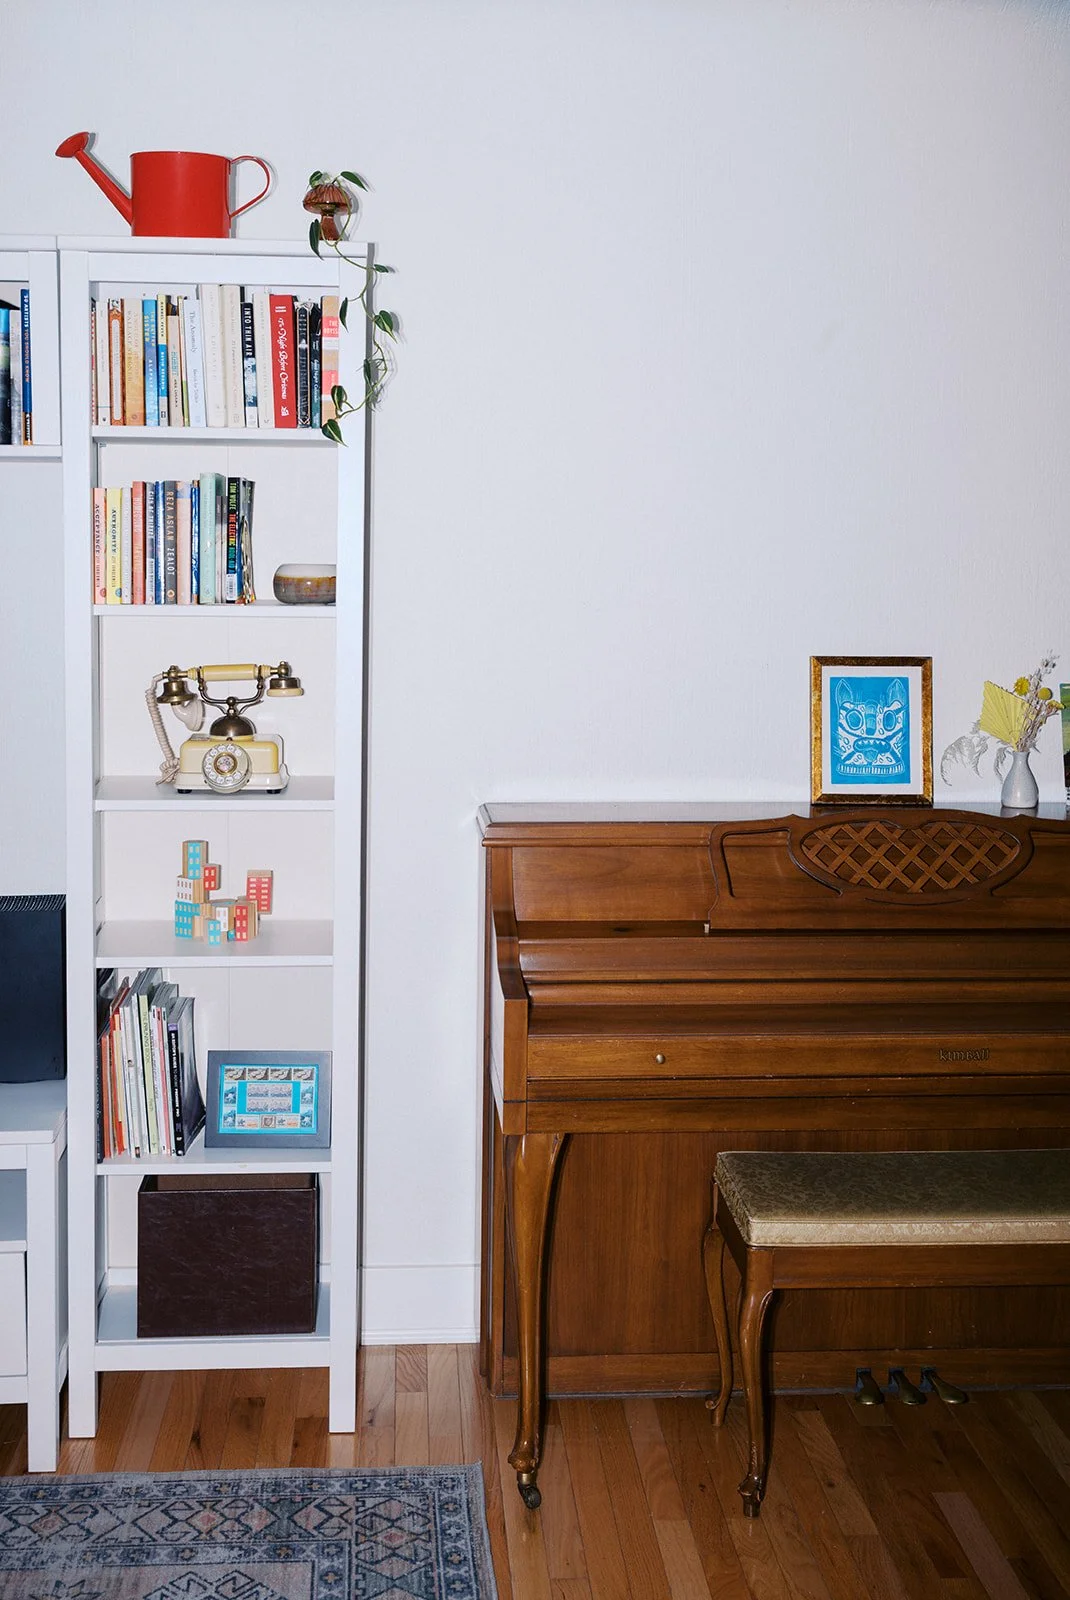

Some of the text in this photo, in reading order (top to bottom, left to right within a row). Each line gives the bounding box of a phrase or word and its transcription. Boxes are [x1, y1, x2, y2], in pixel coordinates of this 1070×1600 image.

[24, 294, 28, 302] 50
[277, 328, 287, 350] Night
[277, 350, 288, 372] Before
[280, 372, 289, 400] Christmas
[166, 491, 176, 576] REZA ASLAN ZEALOT
